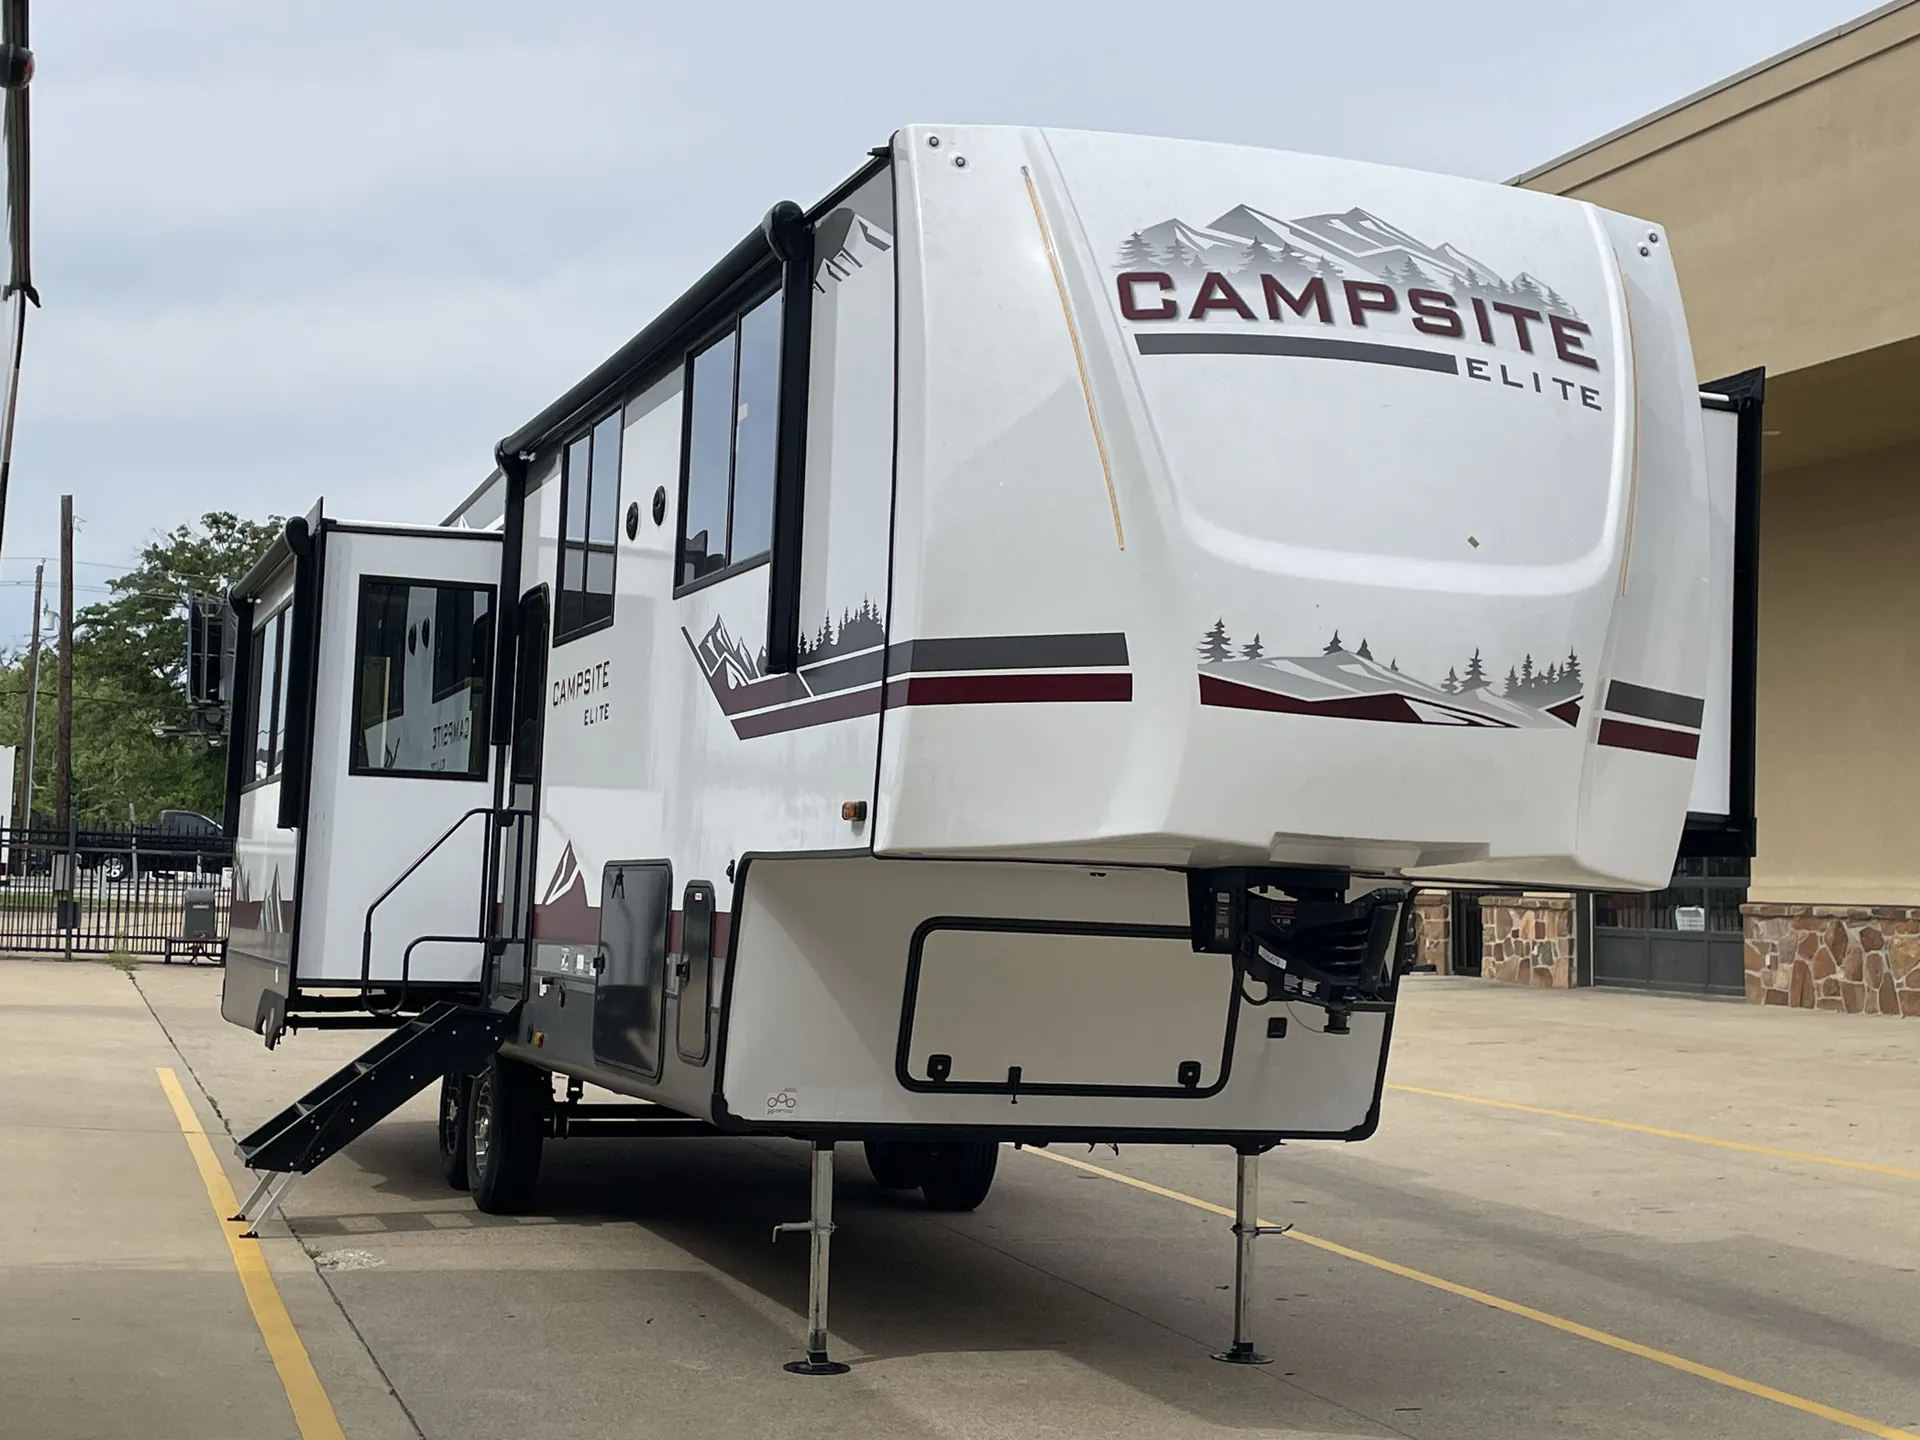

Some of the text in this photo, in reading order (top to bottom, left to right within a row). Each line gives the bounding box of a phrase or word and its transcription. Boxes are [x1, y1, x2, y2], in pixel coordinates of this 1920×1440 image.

[1116, 271, 1601, 371] CAMPSITE
[1466, 357, 1603, 411] ELITE
[553, 660, 610, 707] CAMPSITE
[584, 703, 610, 726] ELITE
